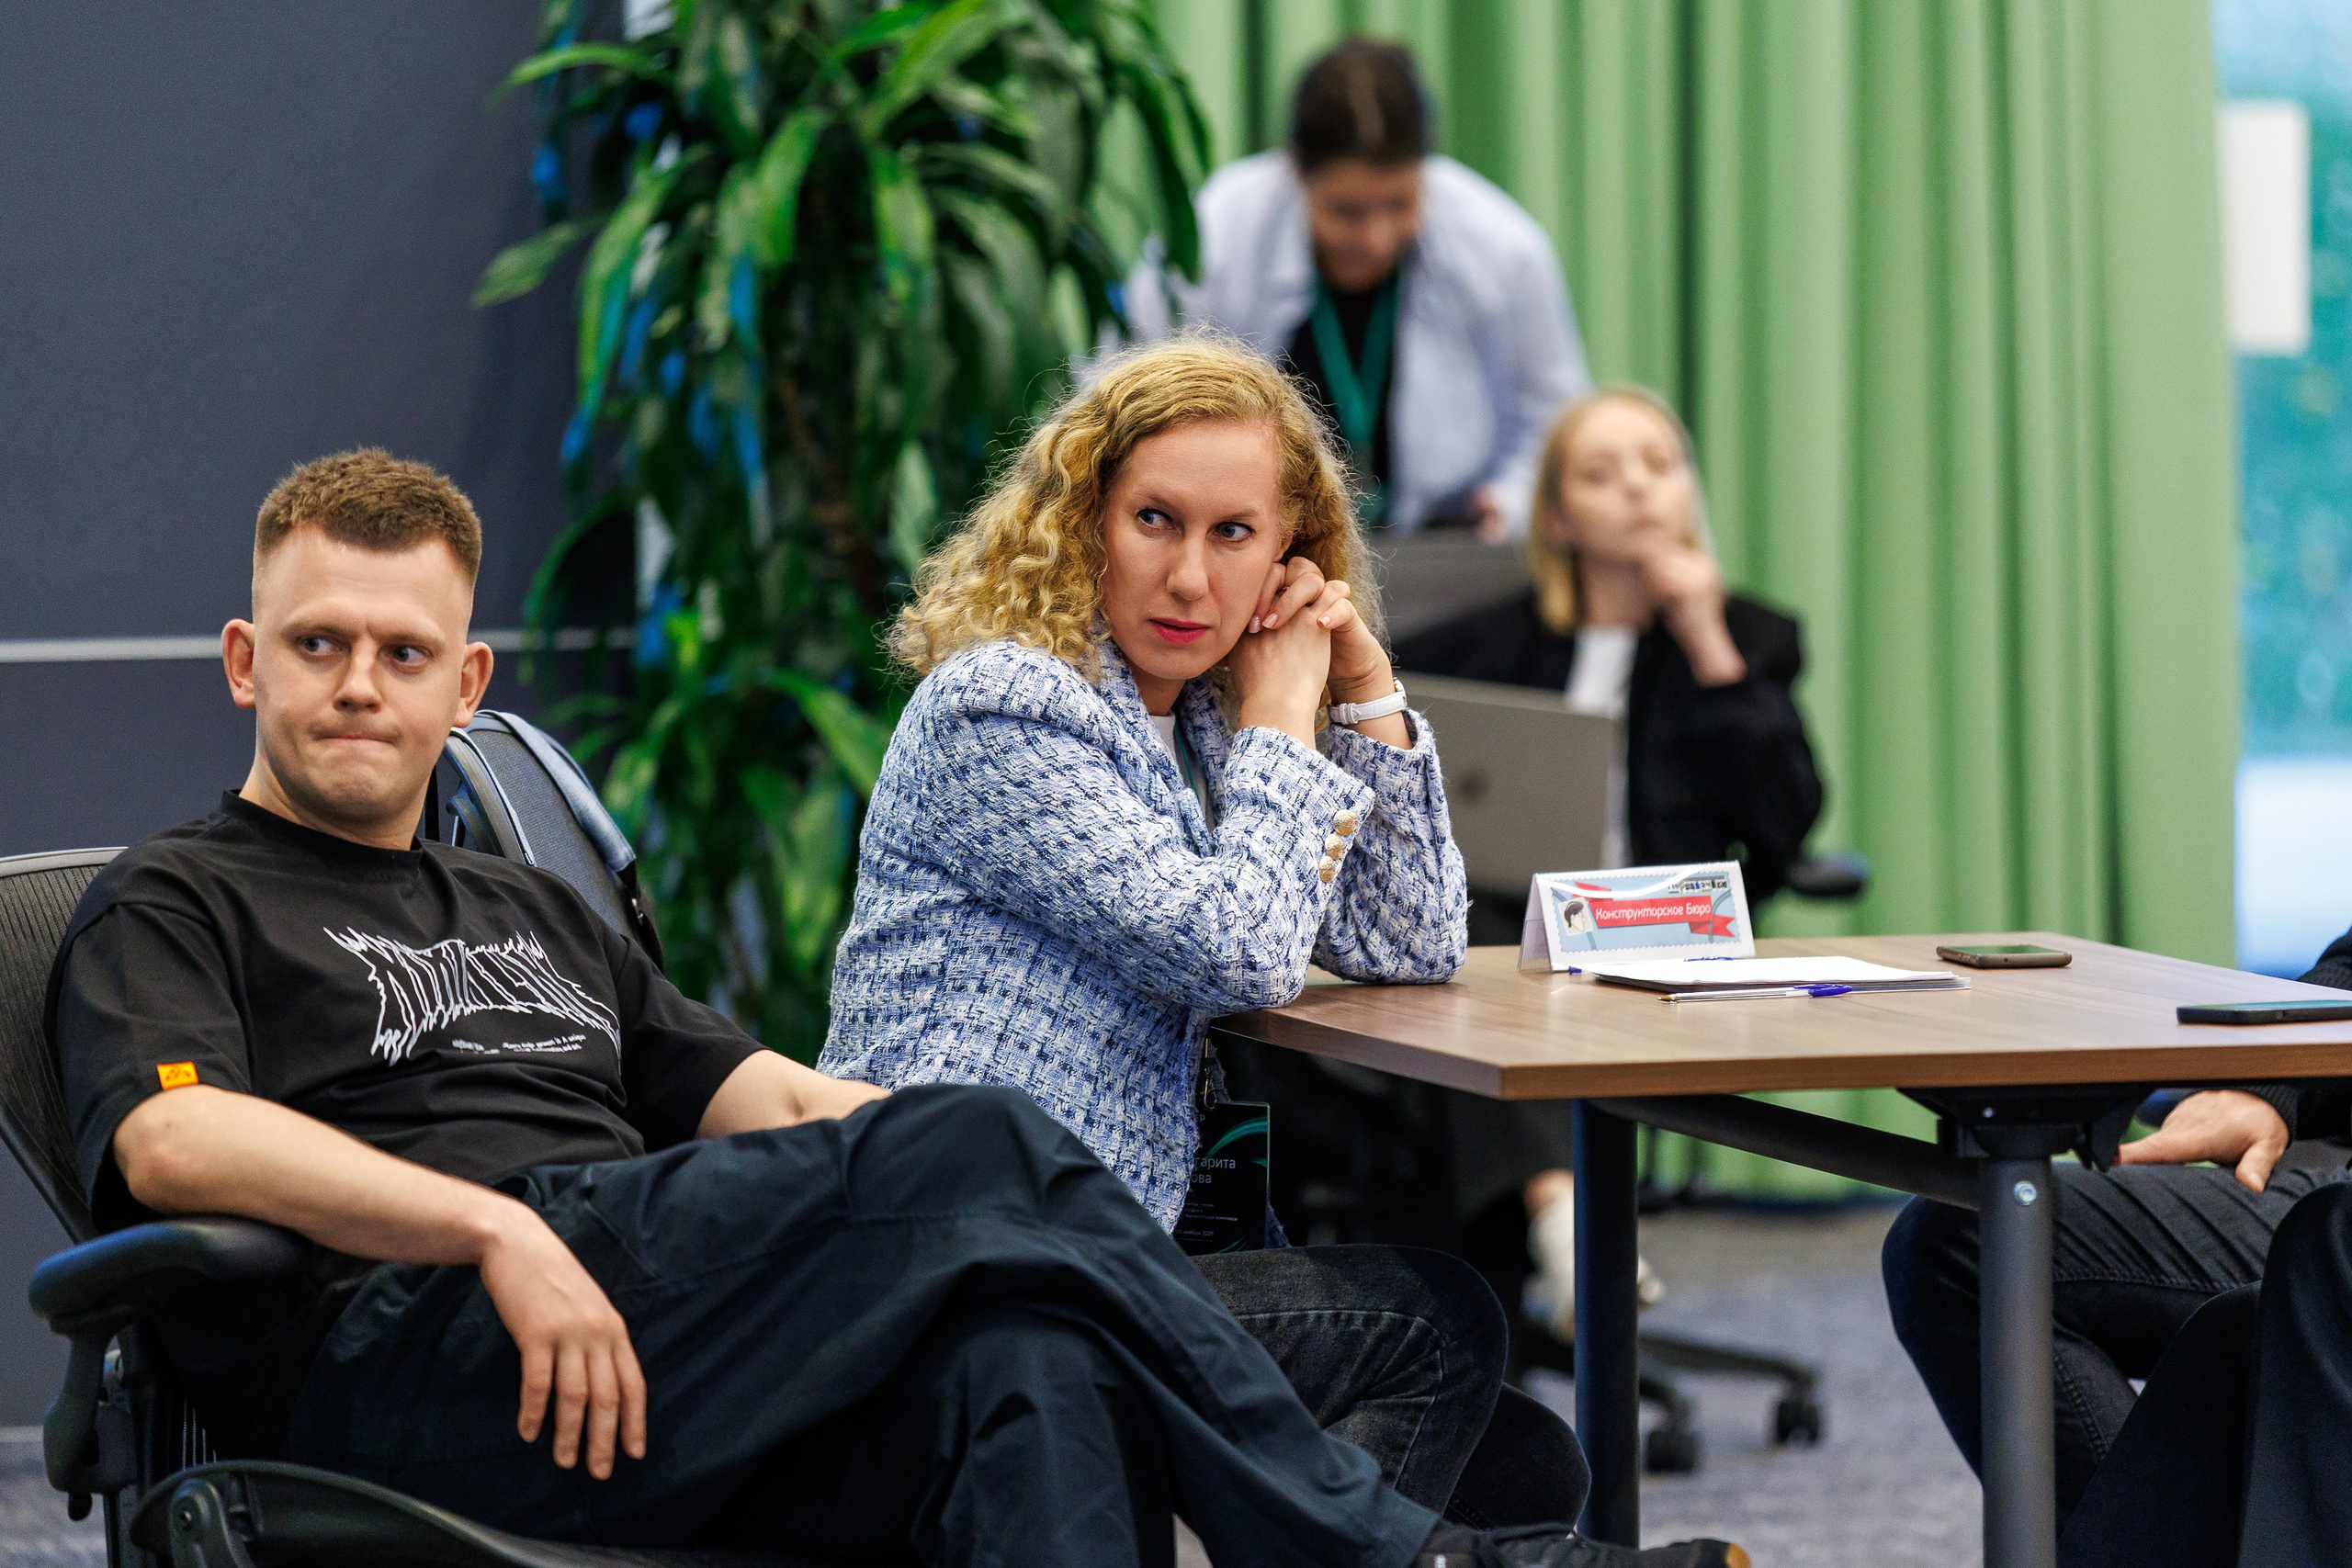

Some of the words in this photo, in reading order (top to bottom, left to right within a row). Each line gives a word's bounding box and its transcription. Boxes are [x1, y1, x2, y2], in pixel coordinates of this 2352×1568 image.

[1595, 906, 1684, 921] Конструкторское
[1685, 902, 1711, 917] Бюро
[1194, 1114, 1206, 1122] ЕР
[1195, 1157, 1236, 1170] гарита
[1192, 1174, 1212, 1184] ова
